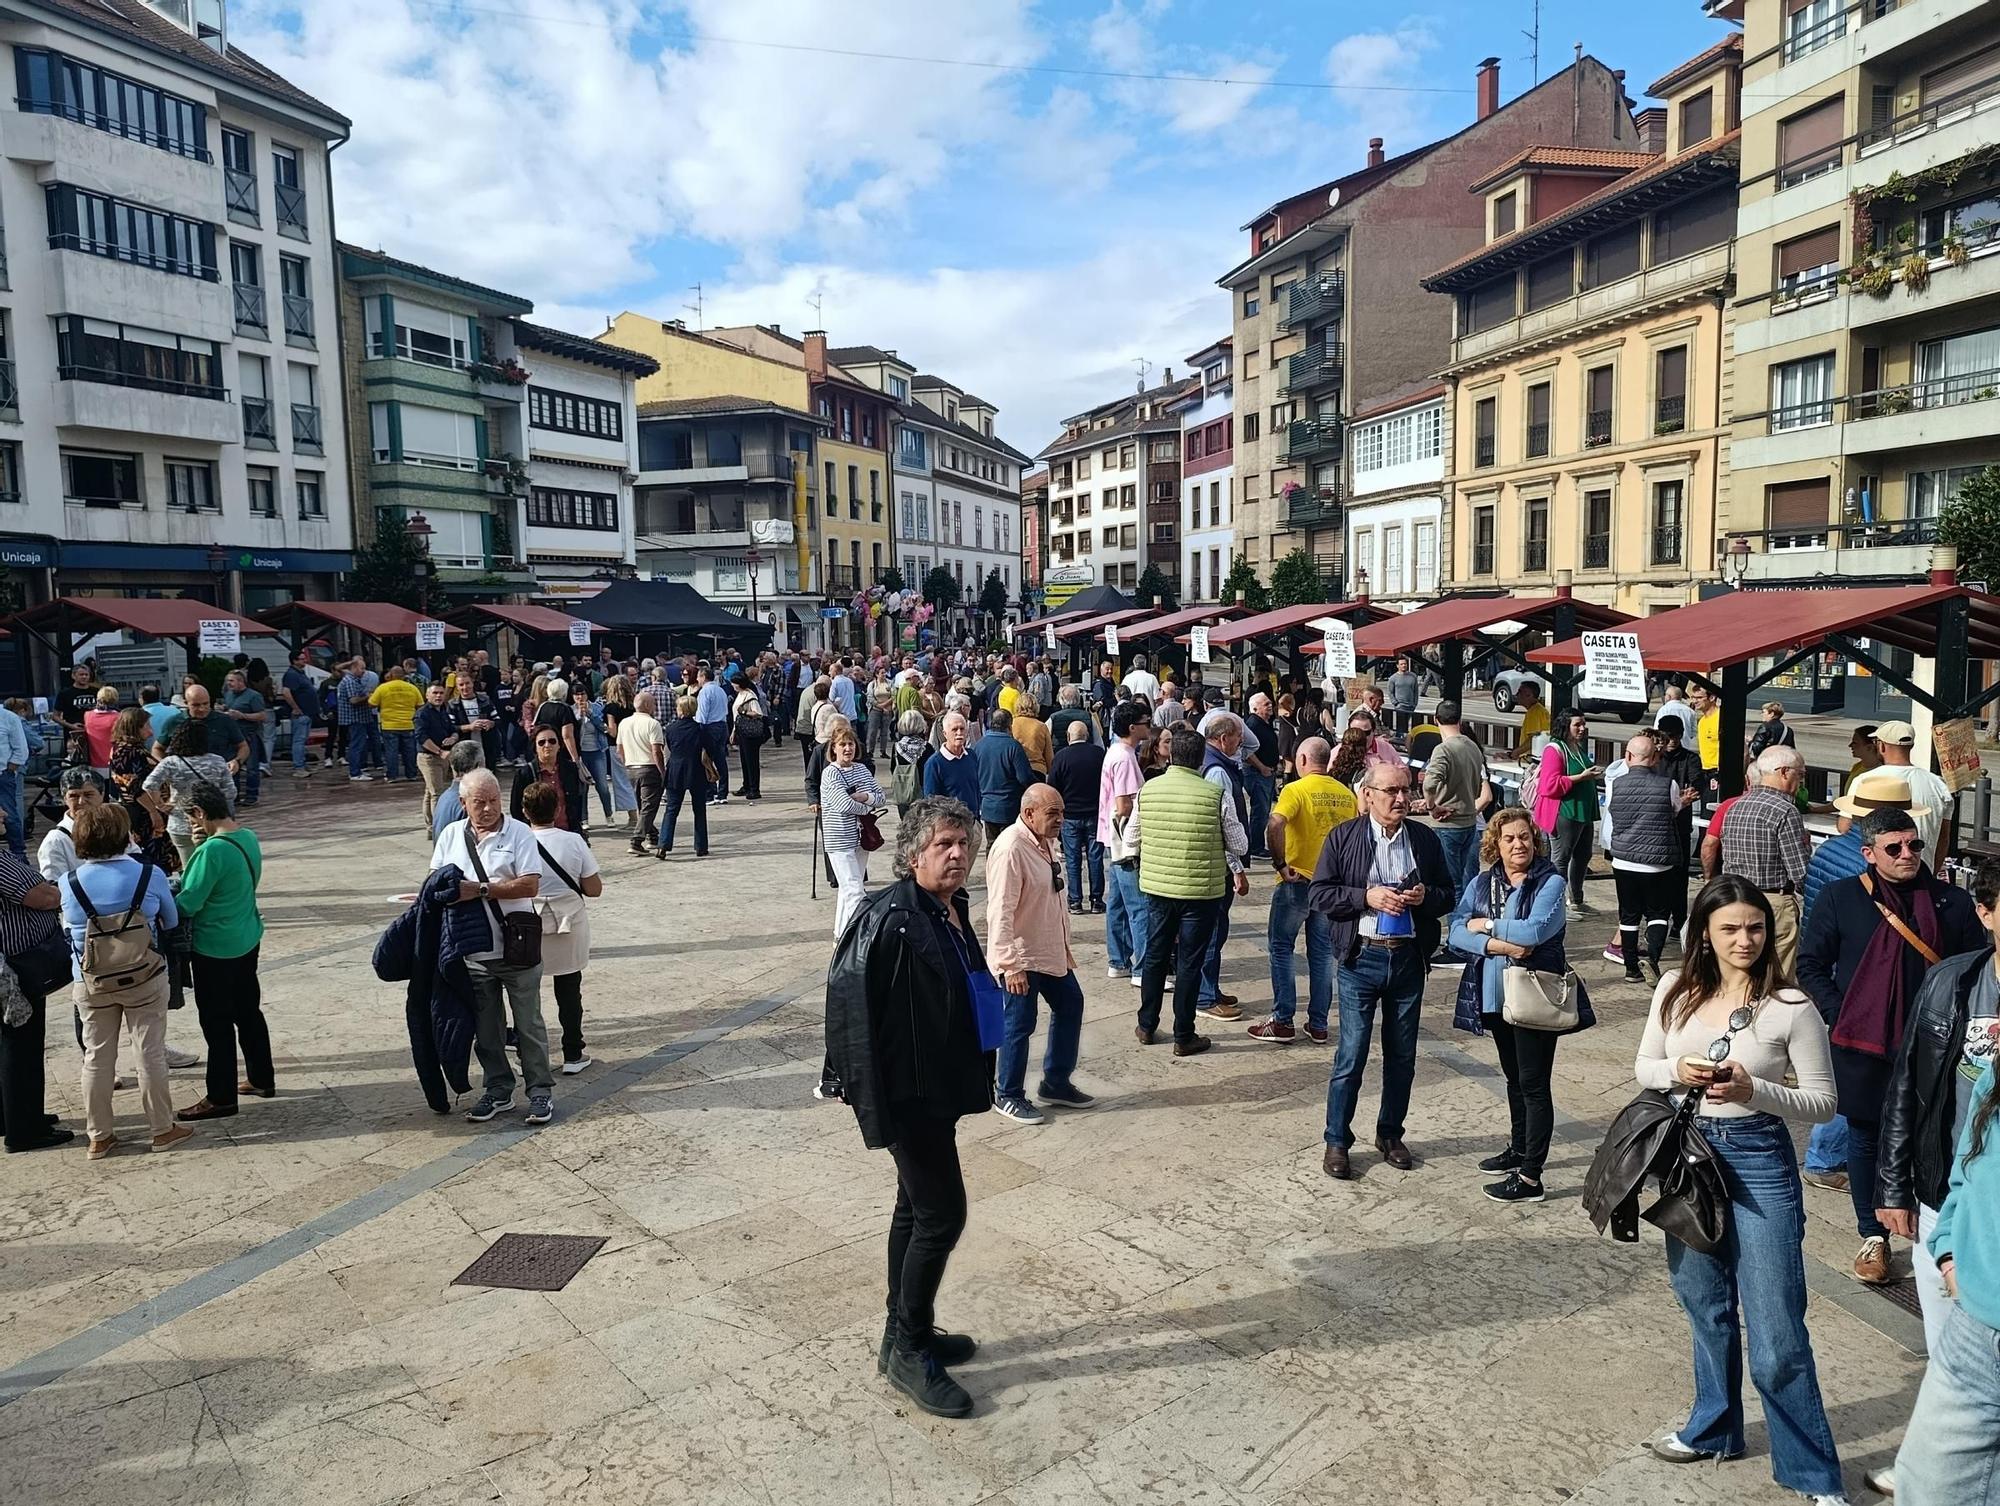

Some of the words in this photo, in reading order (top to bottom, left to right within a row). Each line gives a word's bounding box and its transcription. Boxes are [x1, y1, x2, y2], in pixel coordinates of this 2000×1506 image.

[1, 551, 41, 565] Unicaja
[253, 558, 283, 569] Unicaja
[1325, 632, 1345, 641] CASETA
[1583, 634, 1627, 649] CASETA
[1629, 636, 1636, 649] 9
[73, 697, 98, 706] REPLA
